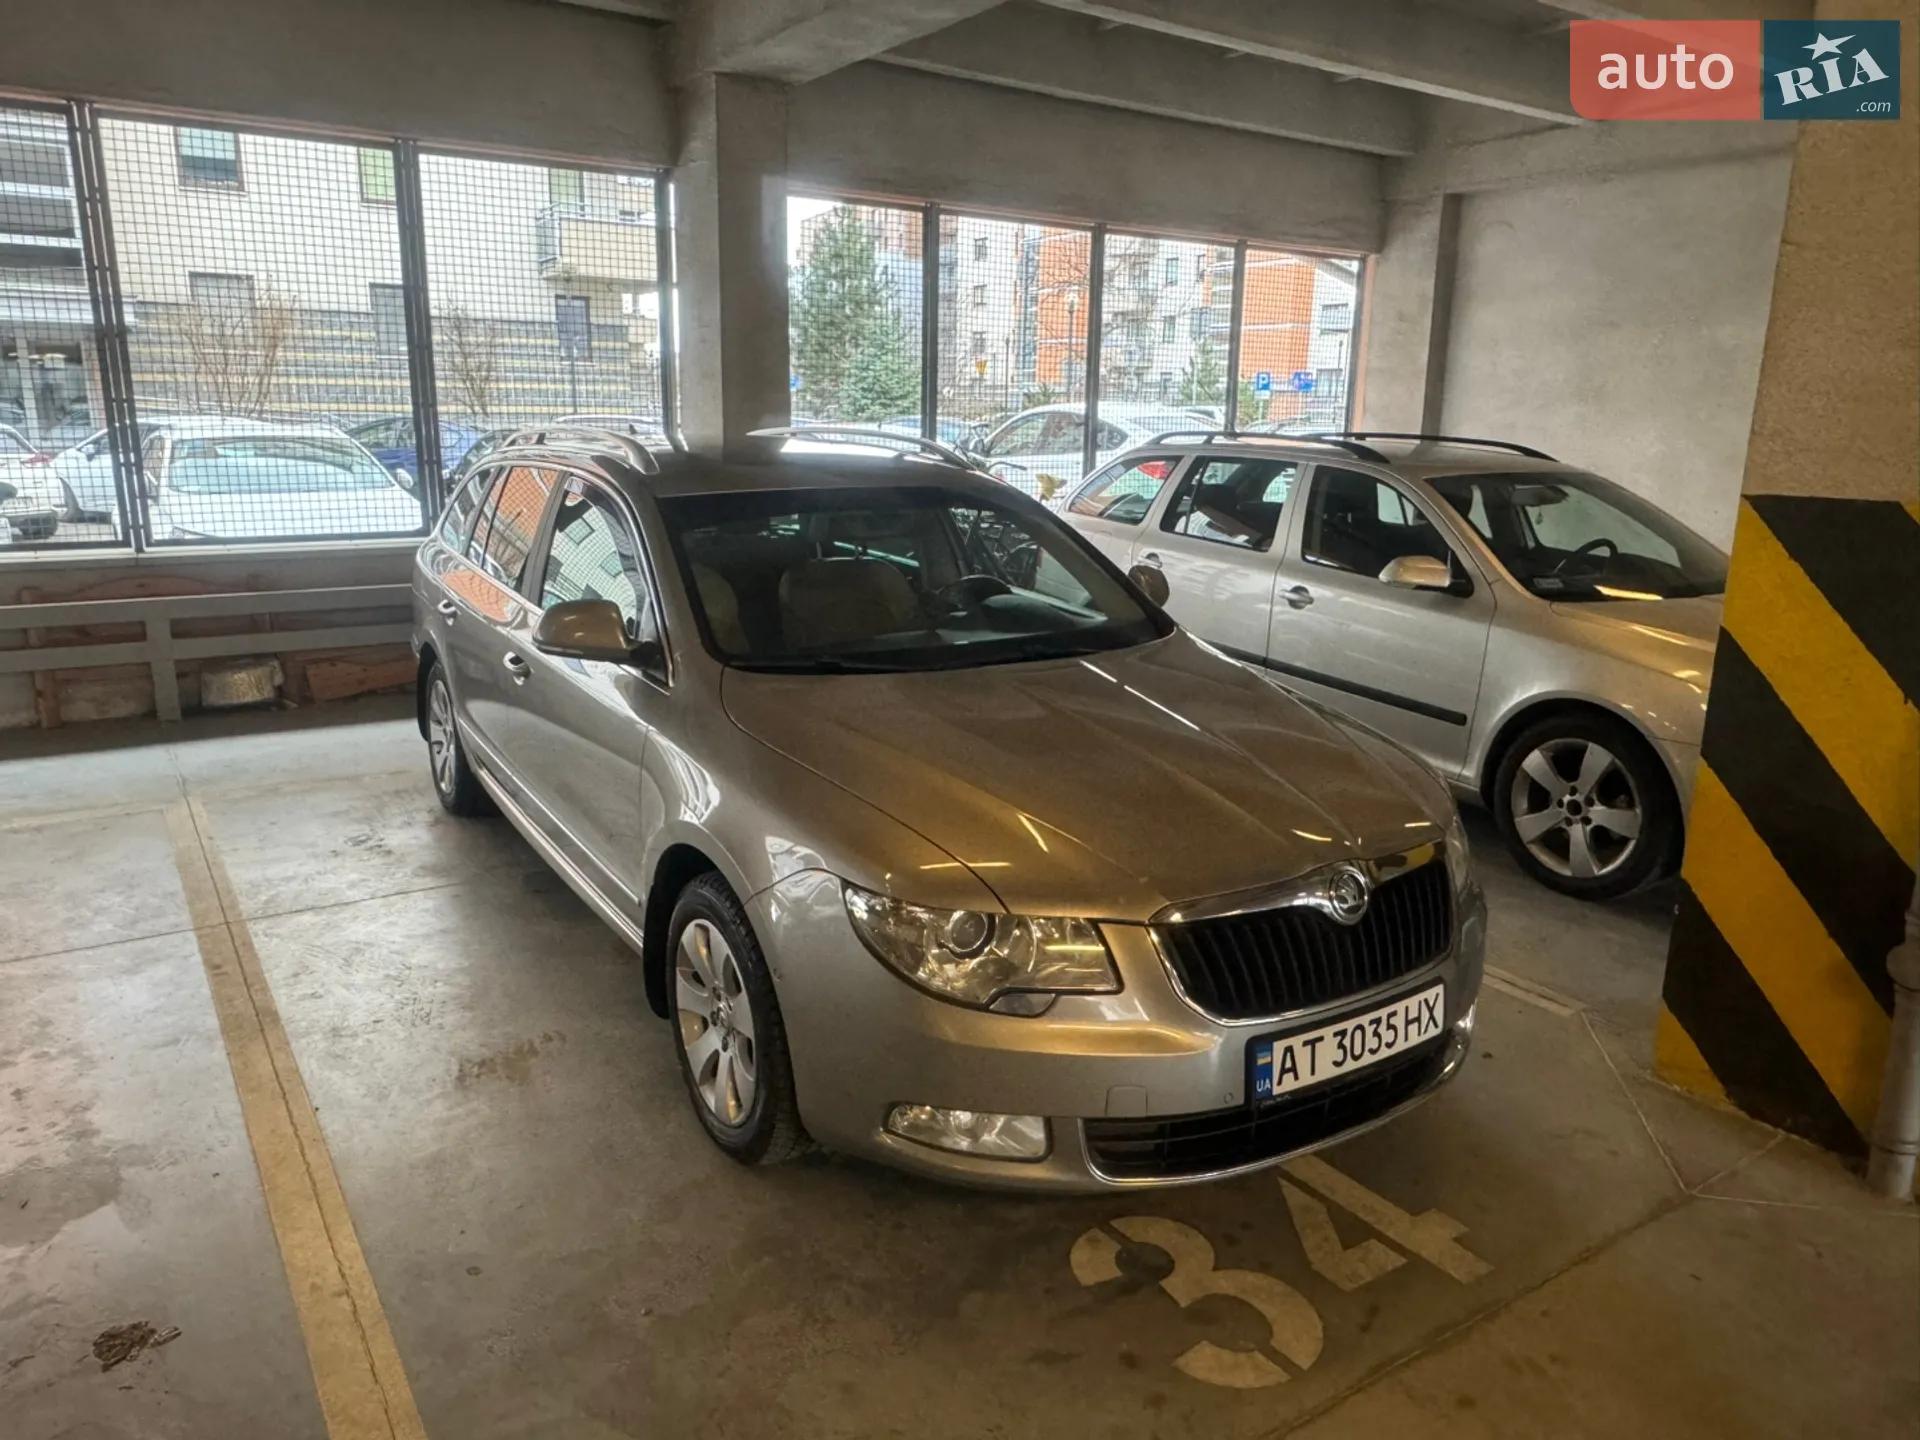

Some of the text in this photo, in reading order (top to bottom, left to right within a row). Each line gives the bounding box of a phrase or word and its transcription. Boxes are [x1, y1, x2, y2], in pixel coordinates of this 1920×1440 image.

[1256, 1079, 1271, 1093] UA
[1276, 992, 1440, 1087] AT 3035 HX
[1069, 1153, 1496, 1389] 34
